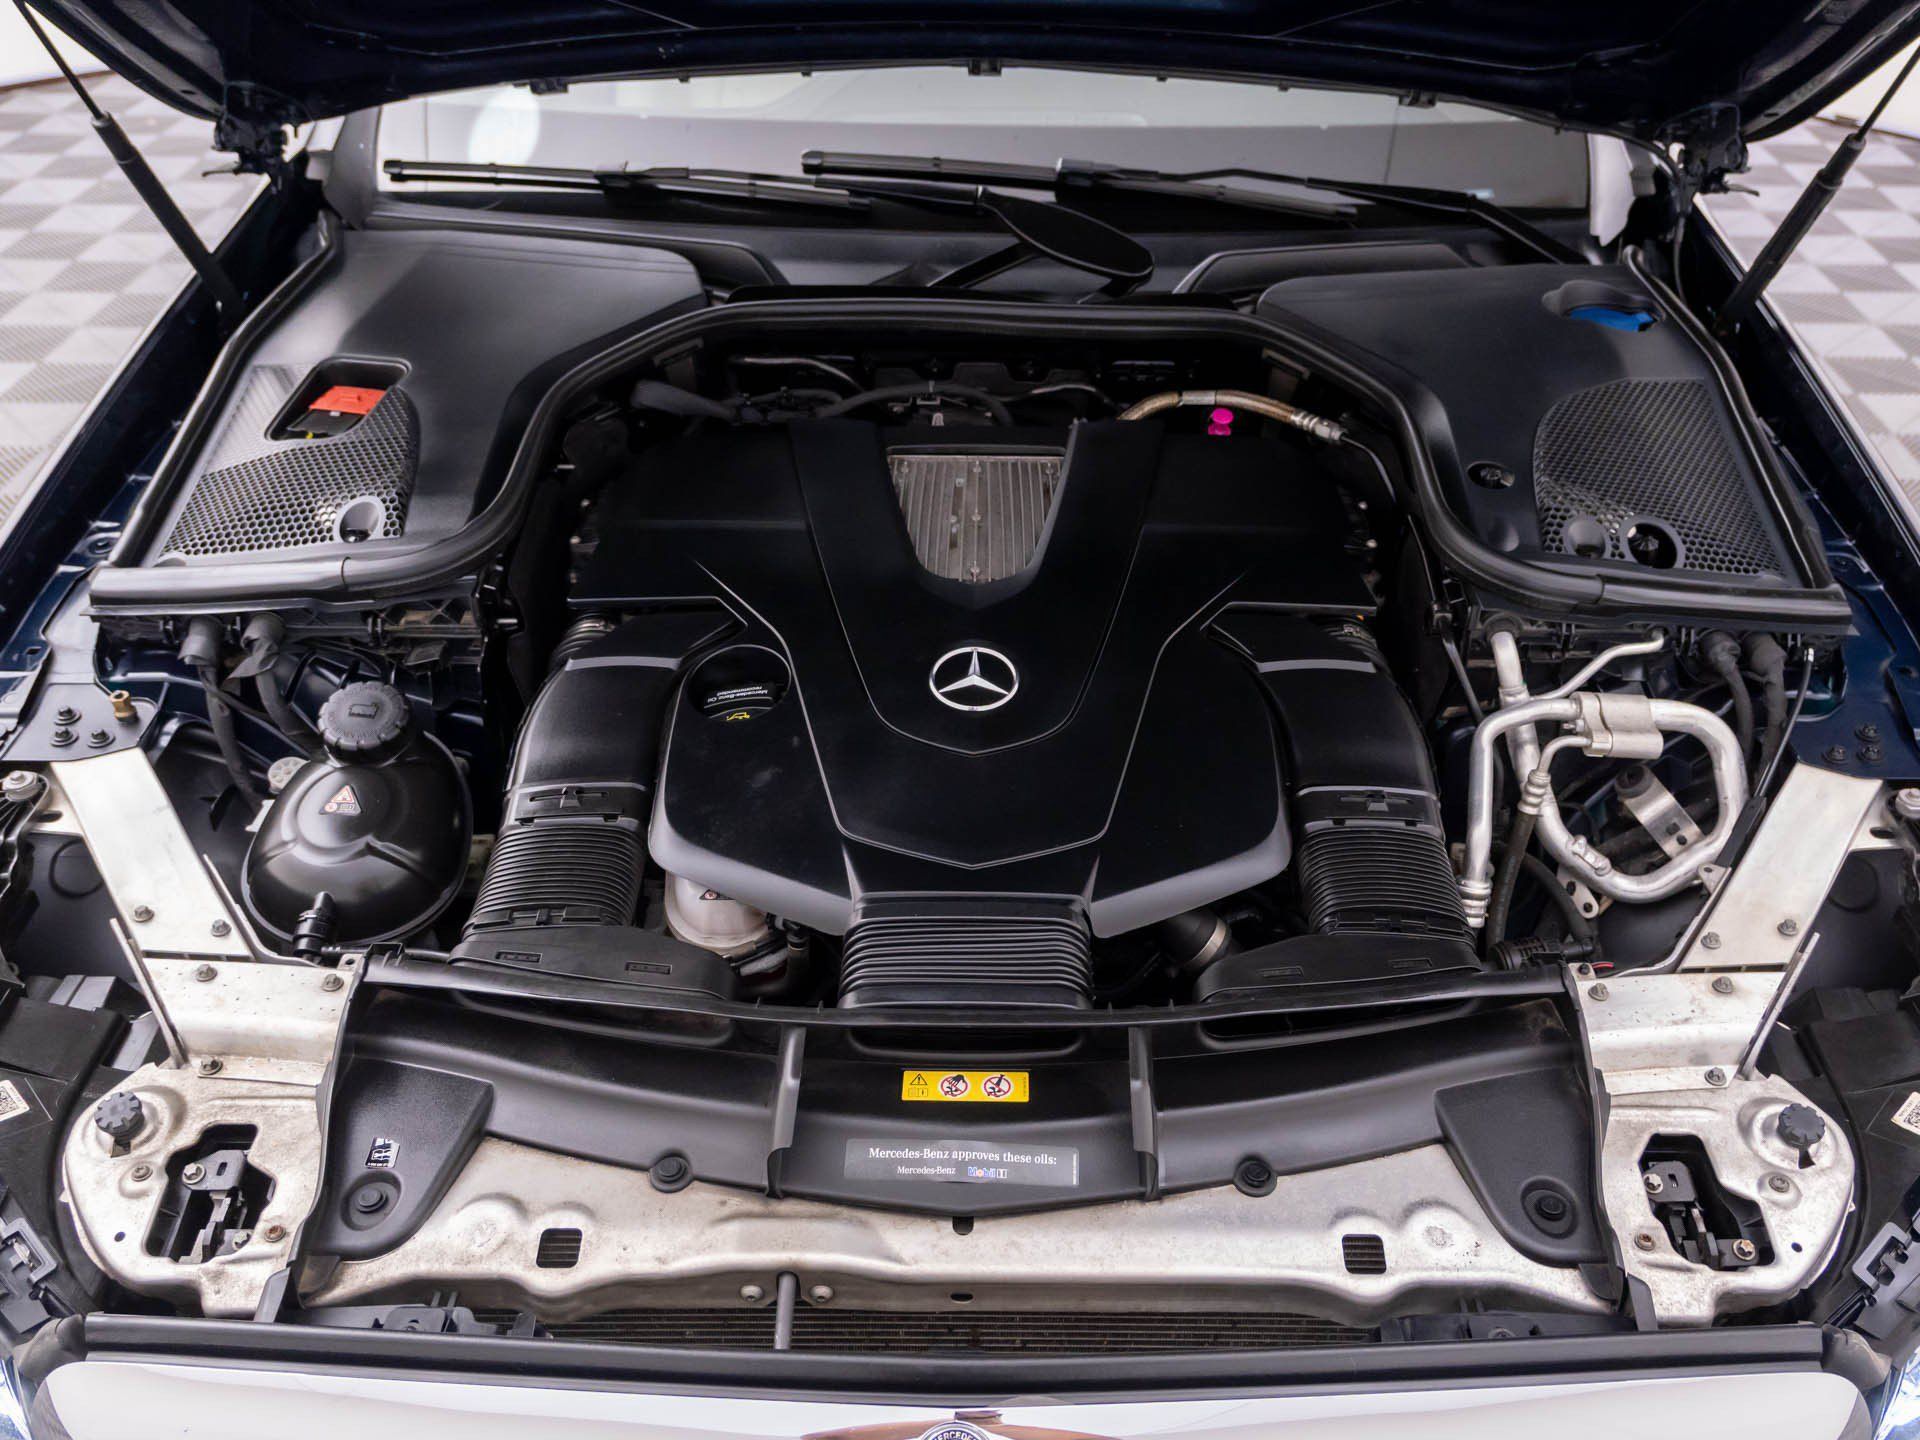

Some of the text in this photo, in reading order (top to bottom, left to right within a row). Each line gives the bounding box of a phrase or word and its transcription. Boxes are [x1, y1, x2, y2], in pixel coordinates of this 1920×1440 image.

[868, 1147, 950, 1159] Mercedes-Benz
[951, 1150, 1000, 1161] approves
[1003, 1152, 1031, 1164] these
[897, 1165, 956, 1175] Mercedes-Benz
